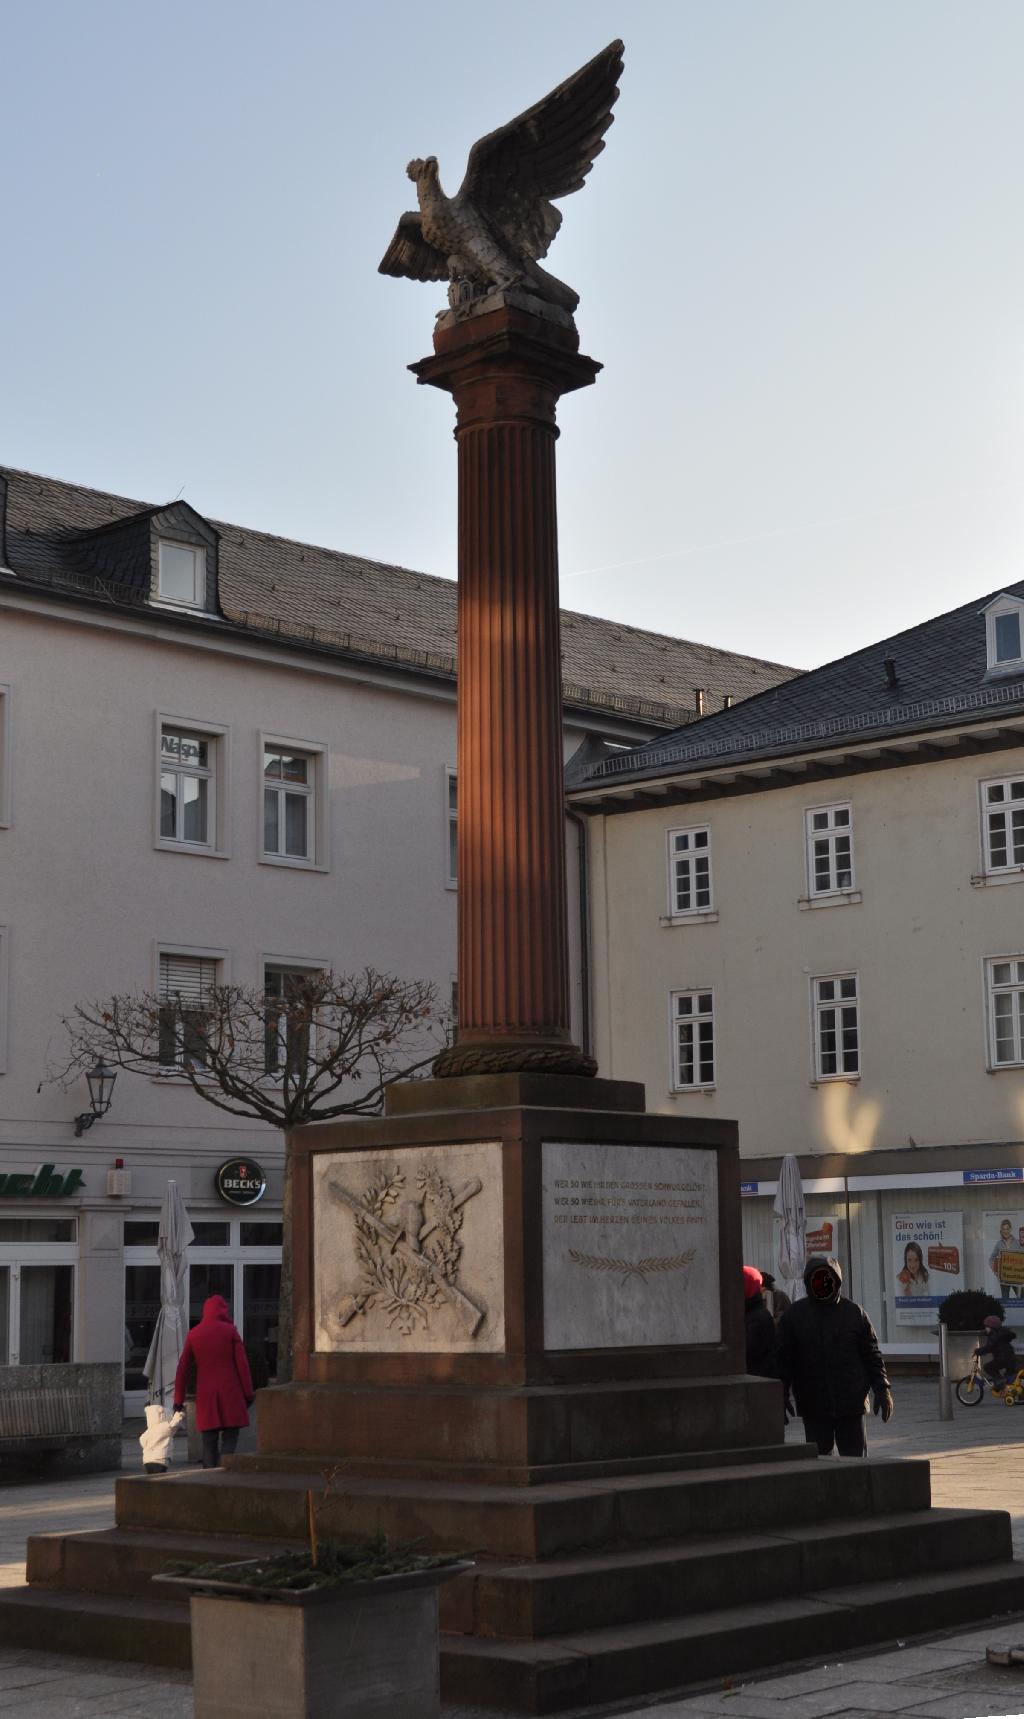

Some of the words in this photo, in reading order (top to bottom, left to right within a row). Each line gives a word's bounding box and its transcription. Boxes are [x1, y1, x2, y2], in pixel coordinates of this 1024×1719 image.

[970, 1171, 1016, 1182] Sparda-Bank
[554, 1180, 569, 1189] WER
[570, 1180, 579, 1189] SO
[581, 1181, 593, 1189] WIE
[554, 1197, 569, 1206] WER
[570, 1197, 580, 1206] SO
[581, 1198, 593, 1206] WIE
[895, 1220, 913, 1230] Giro
[916, 1220, 932, 1229] wie
[935, 1219, 946, 1228] ist
[895, 1231, 911, 1241] das
[913, 1231, 944, 1241] schön!
